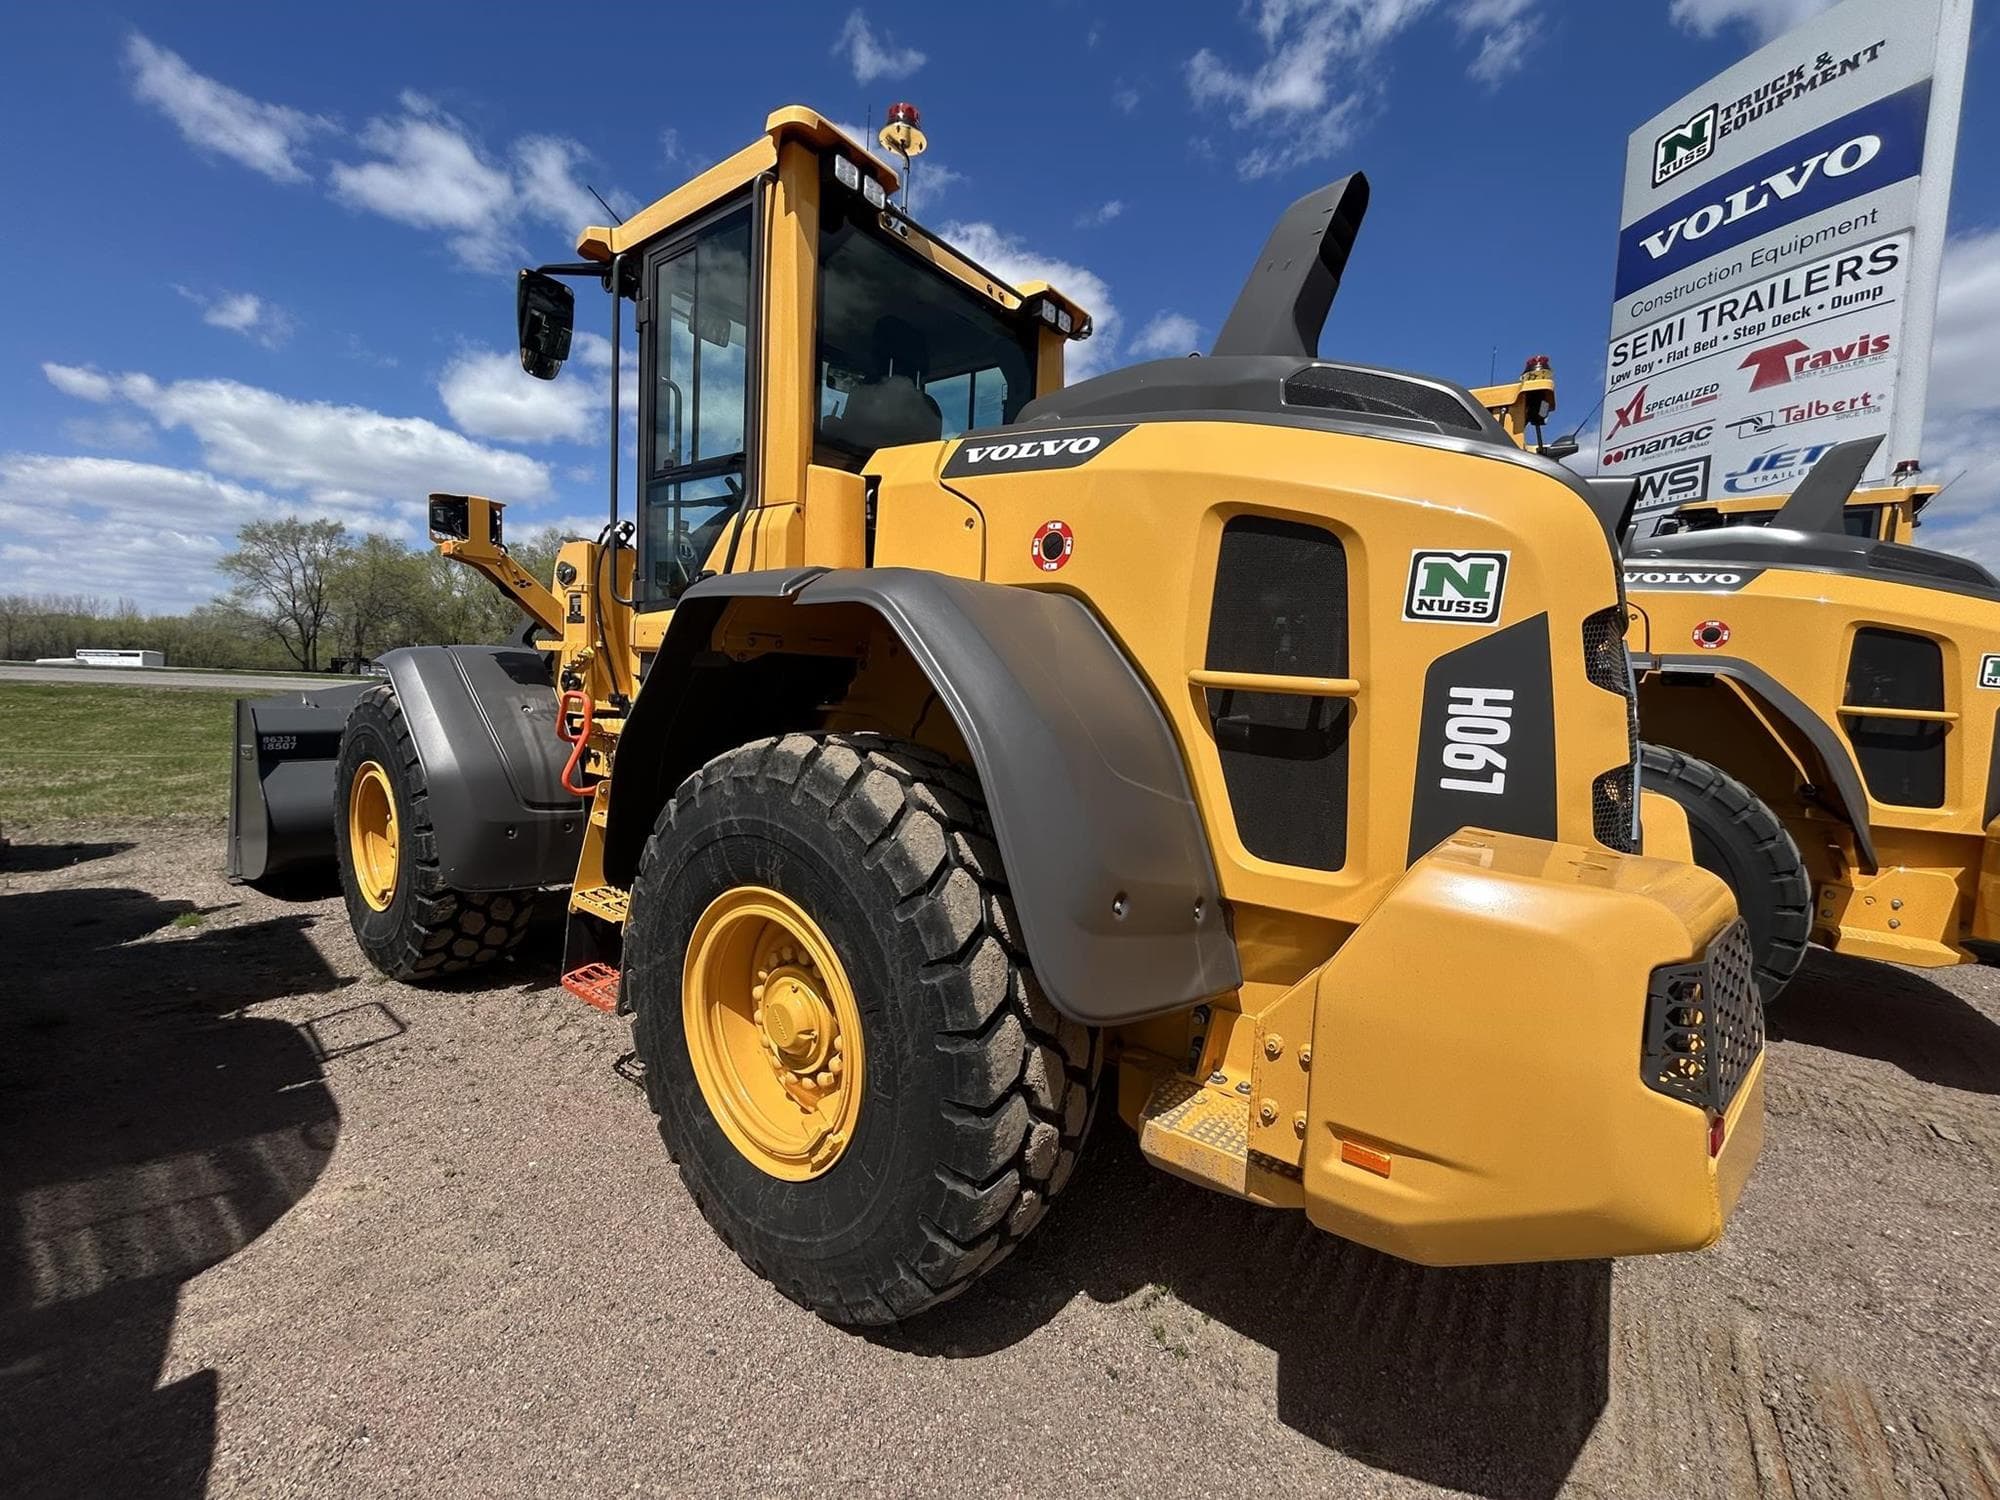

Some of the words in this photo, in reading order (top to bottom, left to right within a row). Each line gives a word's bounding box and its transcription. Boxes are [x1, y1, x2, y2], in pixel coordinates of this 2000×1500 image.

[1718, 40, 1886, 139] EQUIPMENT
[1721, 64, 1804, 121] TRUCK
[1814, 51, 1832, 71] &
[1658, 143, 1708, 180] NUSS
[1638, 134, 1882, 260] VOLVO
[1631, 261, 1743, 318] Construction
[1750, 207, 1878, 269] Equipment
[1611, 317, 1684, 368] SEMI
[1697, 243, 1900, 332] TRAILERS
[1611, 366, 1633, 385] Low
[1634, 360, 1654, 375] Boy
[1666, 350, 1689, 364] Flat
[1693, 335, 1718, 354] Bed
[1732, 320, 1766, 343] Step
[1771, 305, 1811, 328] Deck
[1830, 285, 1884, 310] Dump
[1736, 334, 1890, 393] Travis
[1605, 384, 1655, 441] XL
[1644, 383, 1720, 414] SPECIALIZED
[1779, 391, 1872, 423] Talbert
[966, 436, 1101, 464] VOLVO
[1623, 426, 1714, 461] manac
[1725, 441, 1840, 478] JET
[1634, 464, 1699, 503] WS
[1416, 598, 1489, 614] NUSS
[1623, 572, 1741, 584] VOLVO
[1440, 686, 1514, 795] L90H
